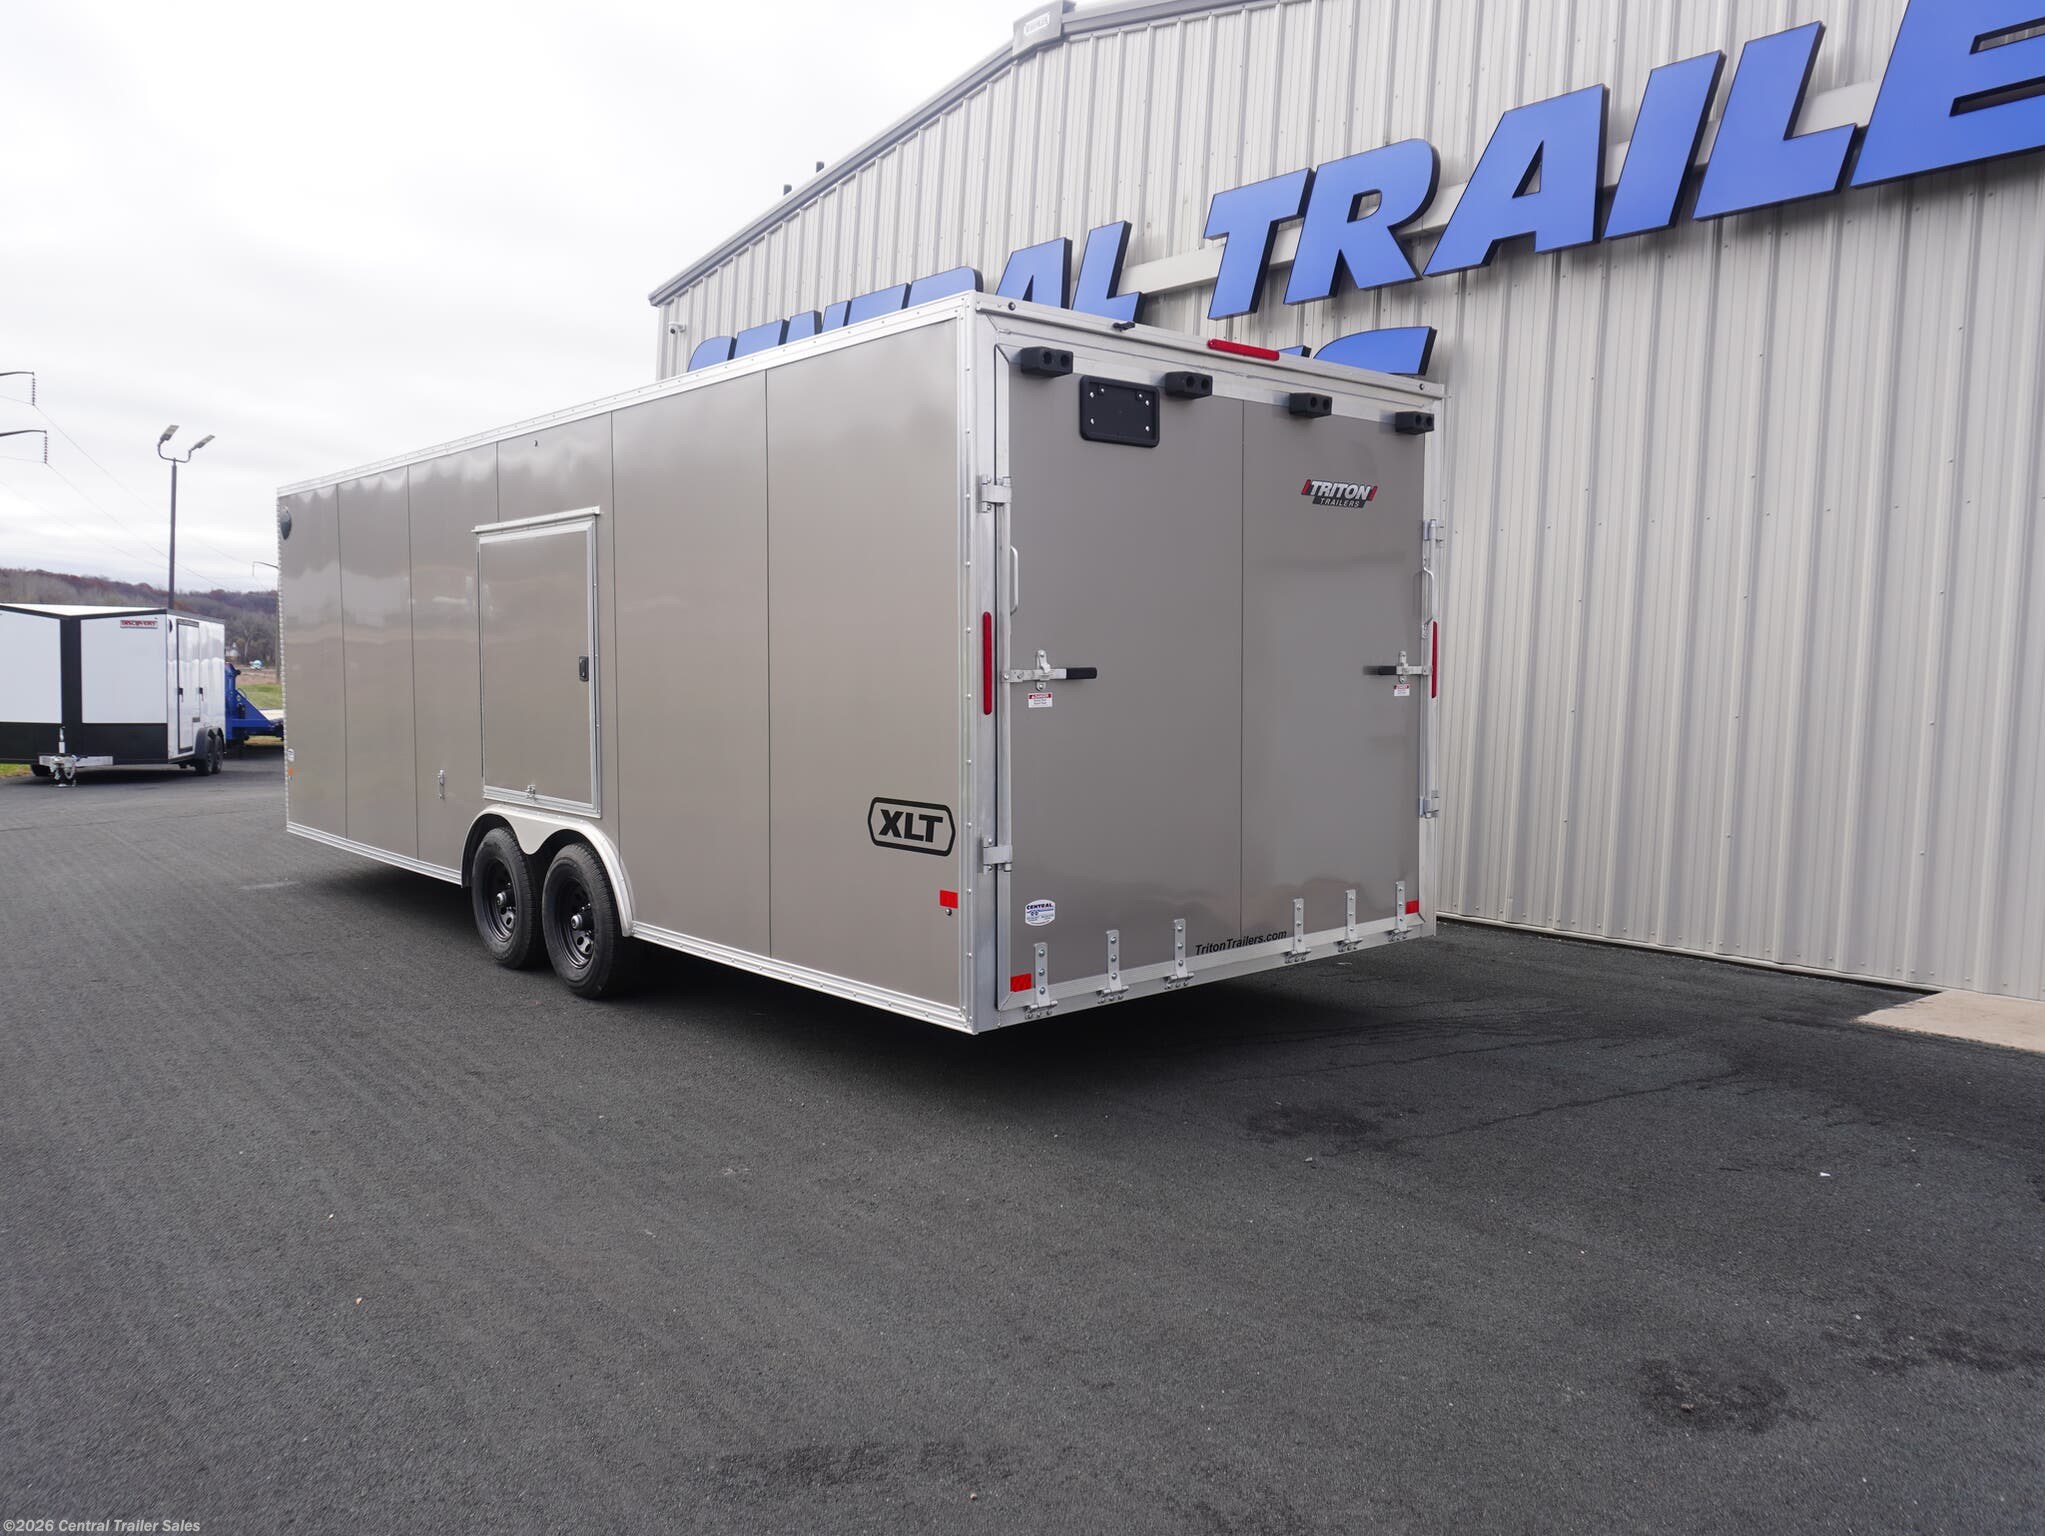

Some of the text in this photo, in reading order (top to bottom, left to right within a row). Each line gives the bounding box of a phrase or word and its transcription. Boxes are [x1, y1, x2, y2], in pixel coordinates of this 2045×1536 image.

[1310, 480, 1371, 501] TRITON
[1320, 497, 1361, 508] TRAILERS
[878, 808, 944, 843] XLT
[1195, 930, 1288, 956] TritonTrailers.com
